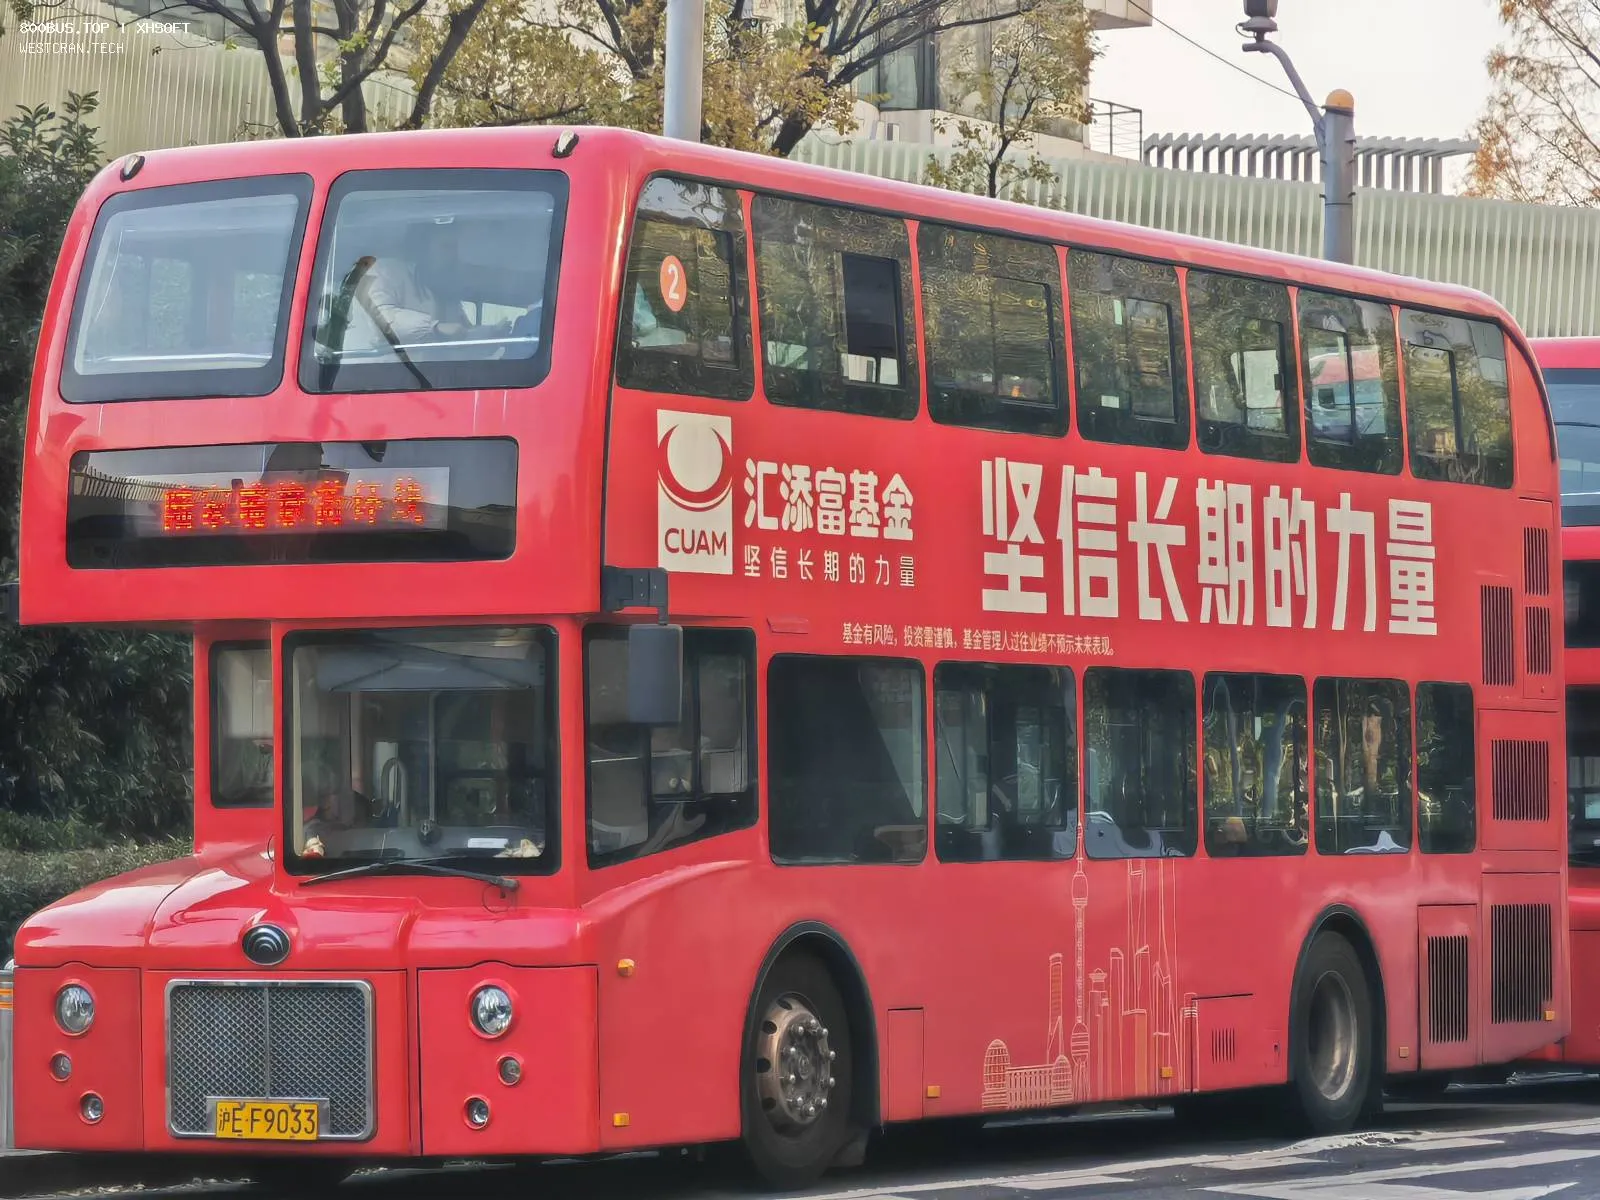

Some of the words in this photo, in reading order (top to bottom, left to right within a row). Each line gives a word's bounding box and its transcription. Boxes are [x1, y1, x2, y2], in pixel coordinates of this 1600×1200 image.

[668, 263, 680, 300] 2
[744, 457, 914, 541] 汇添富基金
[664, 527, 727, 556] CUAM
[981, 457, 1437, 636] 坚信长期的力量
[744, 544, 915, 587] 坚信长期的力量
